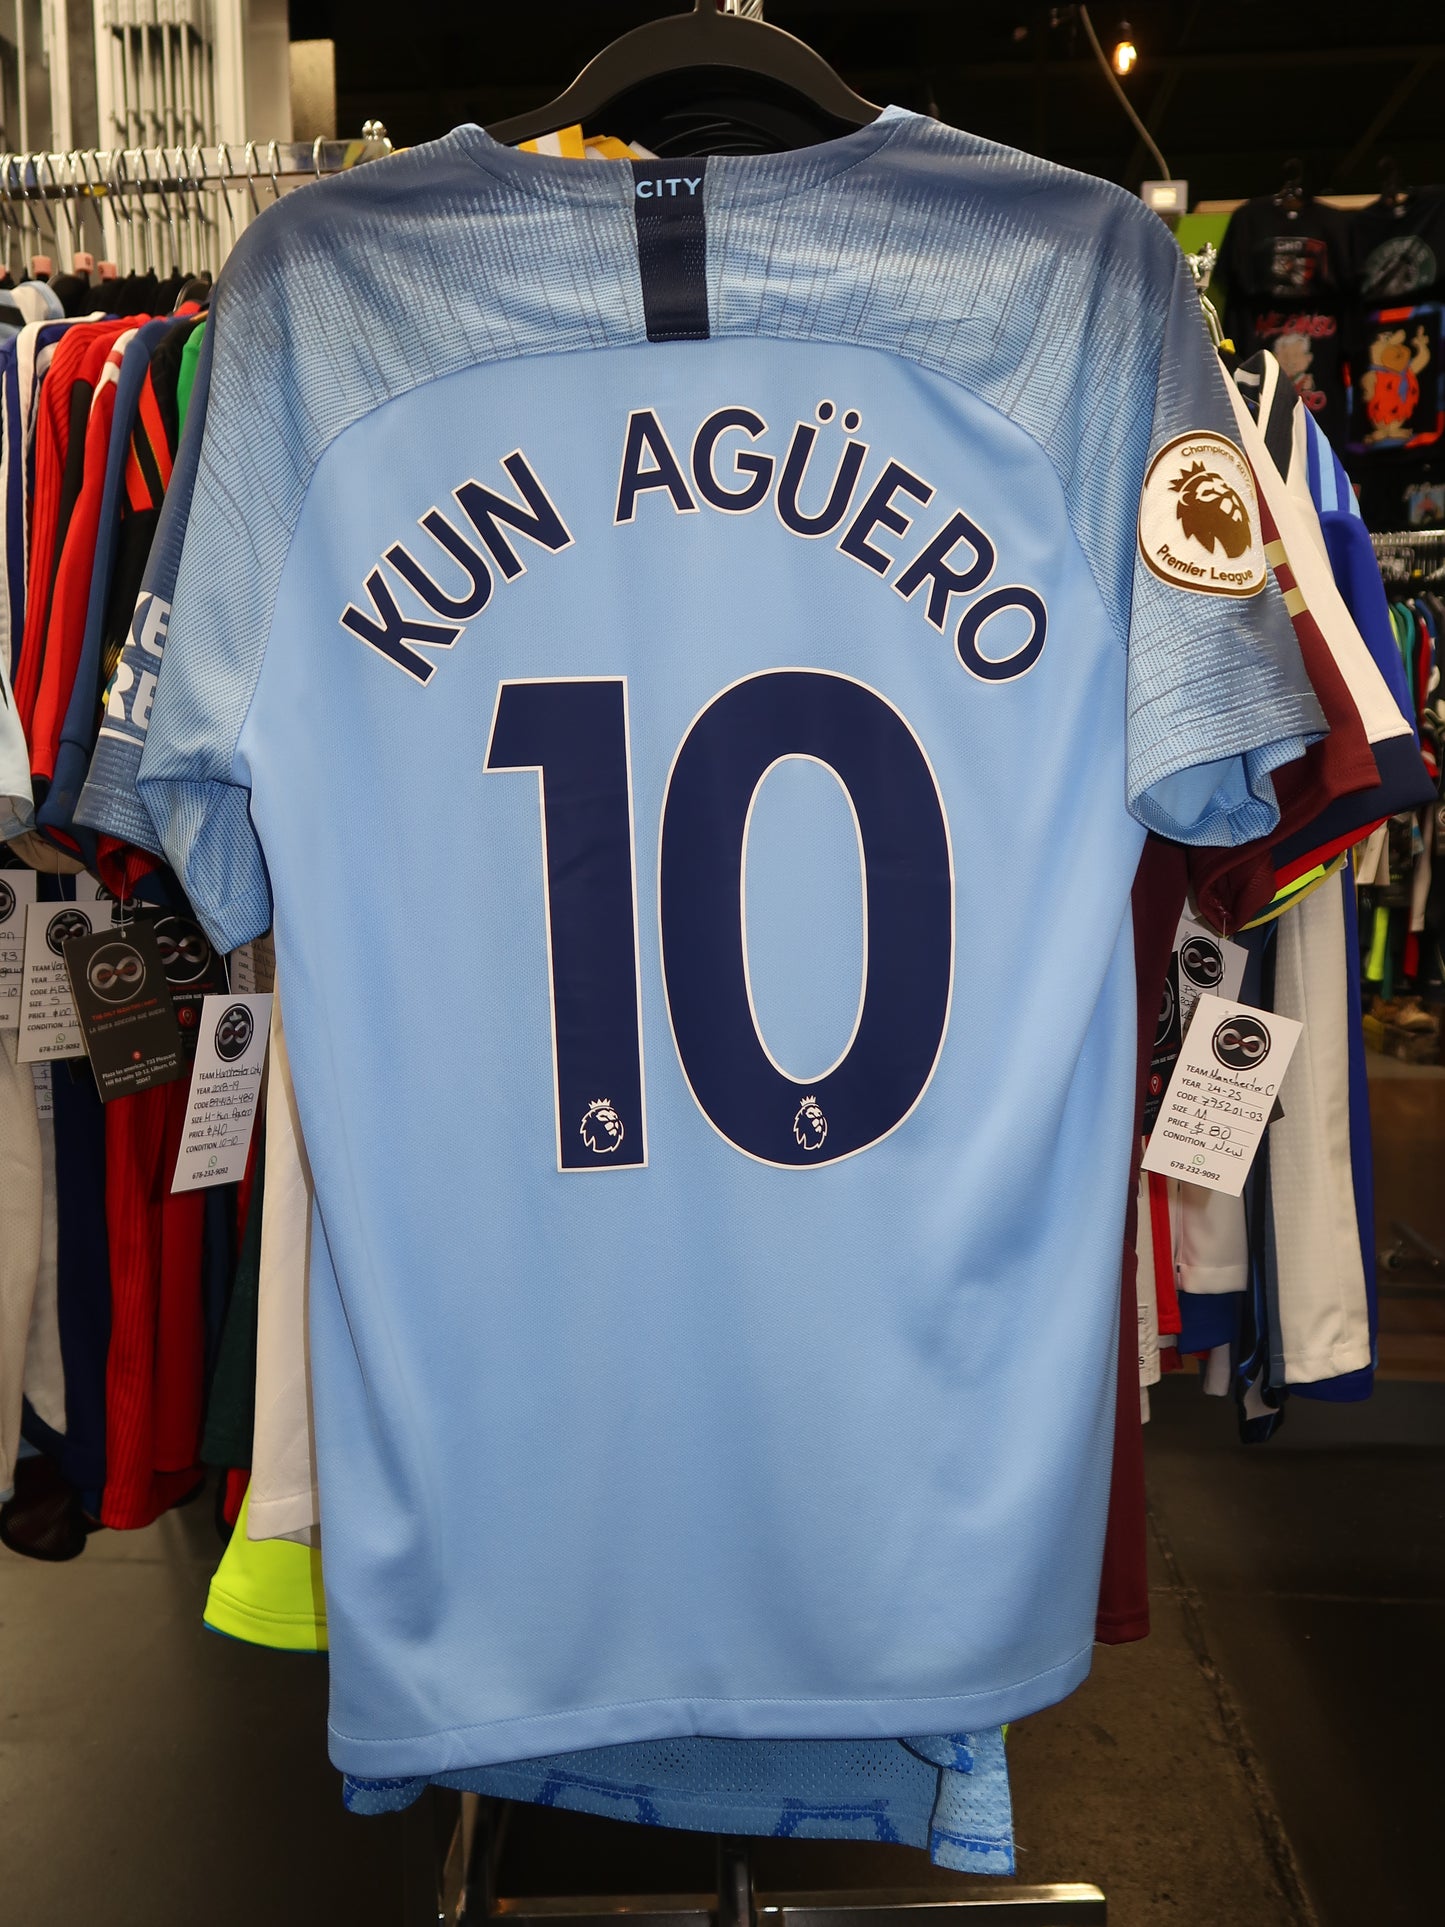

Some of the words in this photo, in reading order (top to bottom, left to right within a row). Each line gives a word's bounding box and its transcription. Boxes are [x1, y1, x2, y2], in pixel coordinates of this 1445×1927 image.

[636, 178, 701, 198] CITY
[1181, 445, 1235, 462] Champions
[339, 447, 575, 687] KUN
[613, 399, 1048, 685] AGÜERO
[1157, 544, 1206, 578] Premier
[1210, 567, 1253, 585] League
[482, 666, 955, 1173] 10
[27, 1022, 63, 1031] CONDITION
[199, 1072, 215, 1080] TEAM
[1186, 1064, 1208, 1076] TEAM
[1265, 1084, 1275, 1096] C
[197, 1087, 210, 1095] YEAR
[1177, 1091, 1197, 1102] CODE
[1181, 1078, 1201, 1089] YEAR
[1207, 1083, 1241, 1101] 24-25
[194, 1102, 208, 1110] CODE
[1172, 1104, 1188, 1114] SIZE
[1195, 1108, 1207, 1120] M
[191, 1116, 202, 1124] SIZE
[1167, 1117, 1189, 1129] PRICE
[186, 1142, 217, 1154] CONDITION
[1163, 1130, 1206, 1148] CONDITION
[1213, 1141, 1243, 1157] New
[192, 1167, 229, 1180] 678-232-9092
[1170, 1160, 1220, 1181] 678-232-9092
